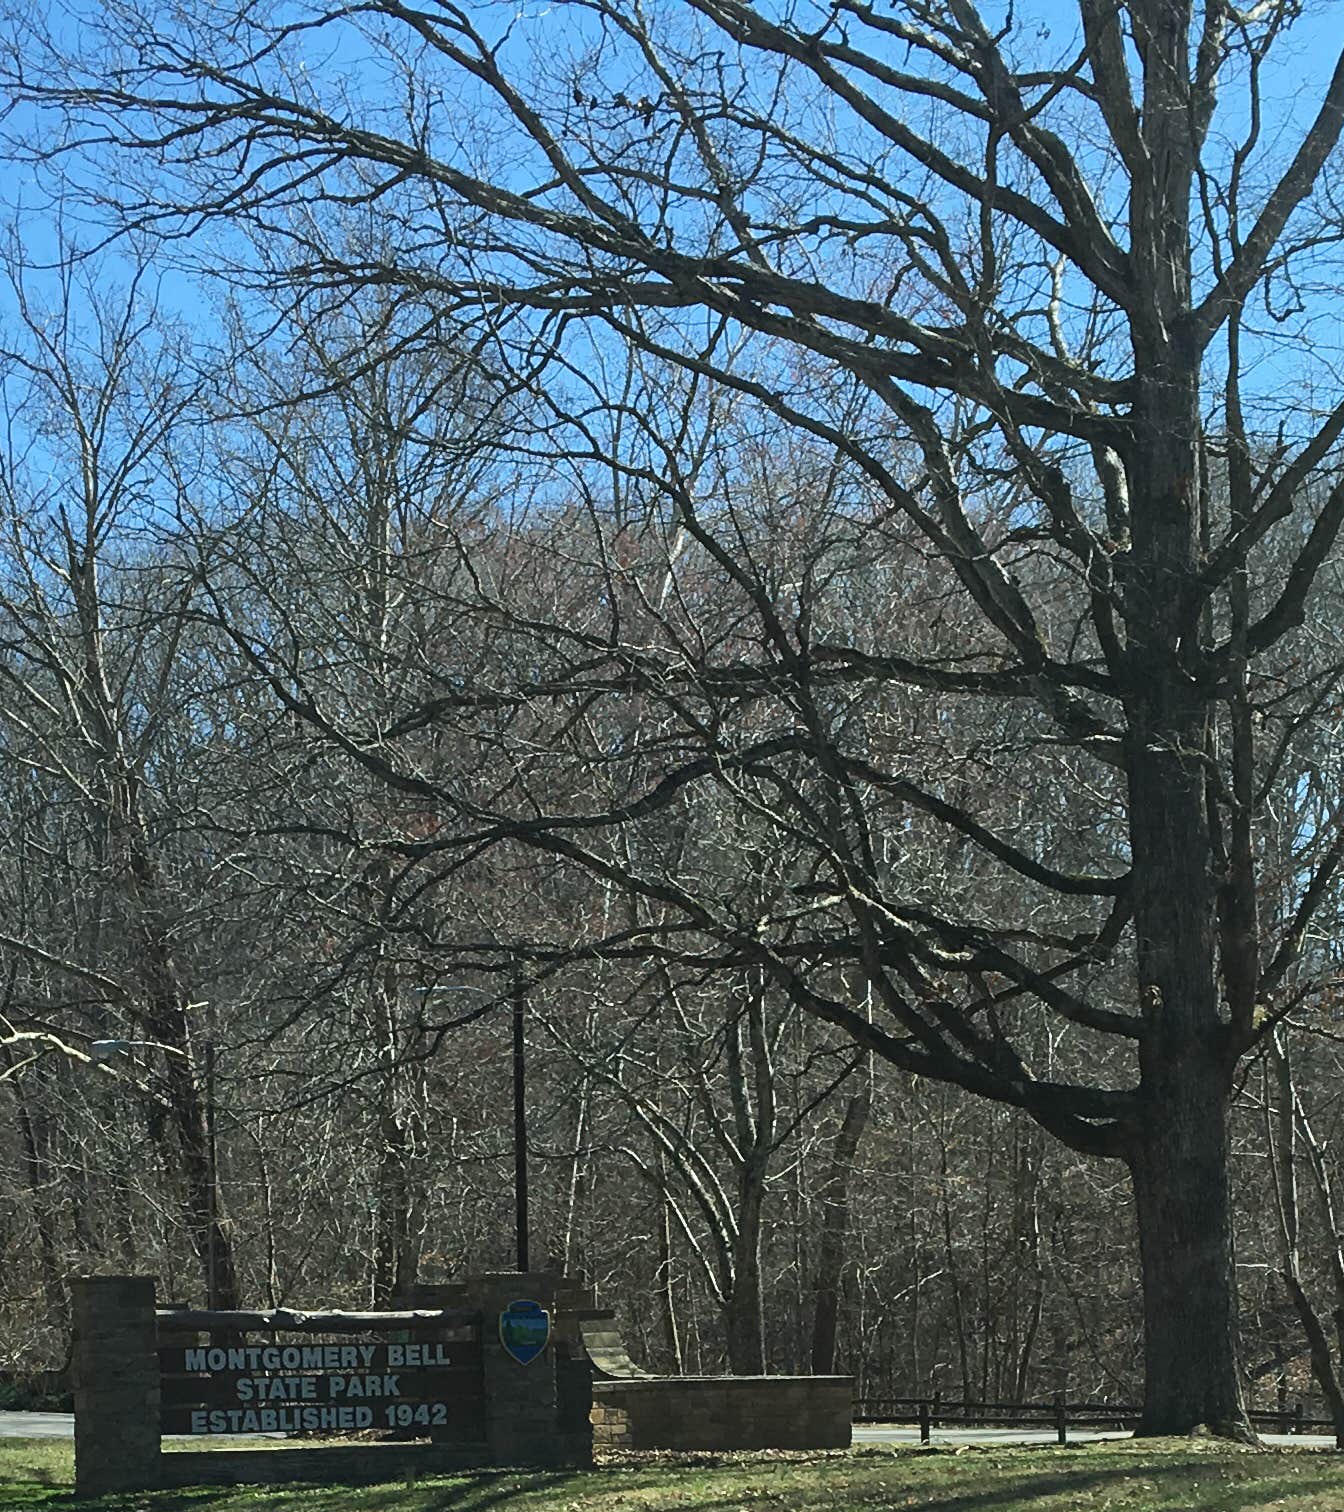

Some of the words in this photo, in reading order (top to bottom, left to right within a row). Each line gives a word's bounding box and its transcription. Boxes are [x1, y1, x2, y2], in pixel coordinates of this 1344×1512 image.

[185, 1345, 376, 1371] MONTGOMERY
[387, 1344, 451, 1366] BELL
[236, 1378, 317, 1401] STATE
[329, 1375, 401, 1397] PARK
[191, 1406, 373, 1433] ESTABLISHED
[385, 1403, 448, 1426] 1942
